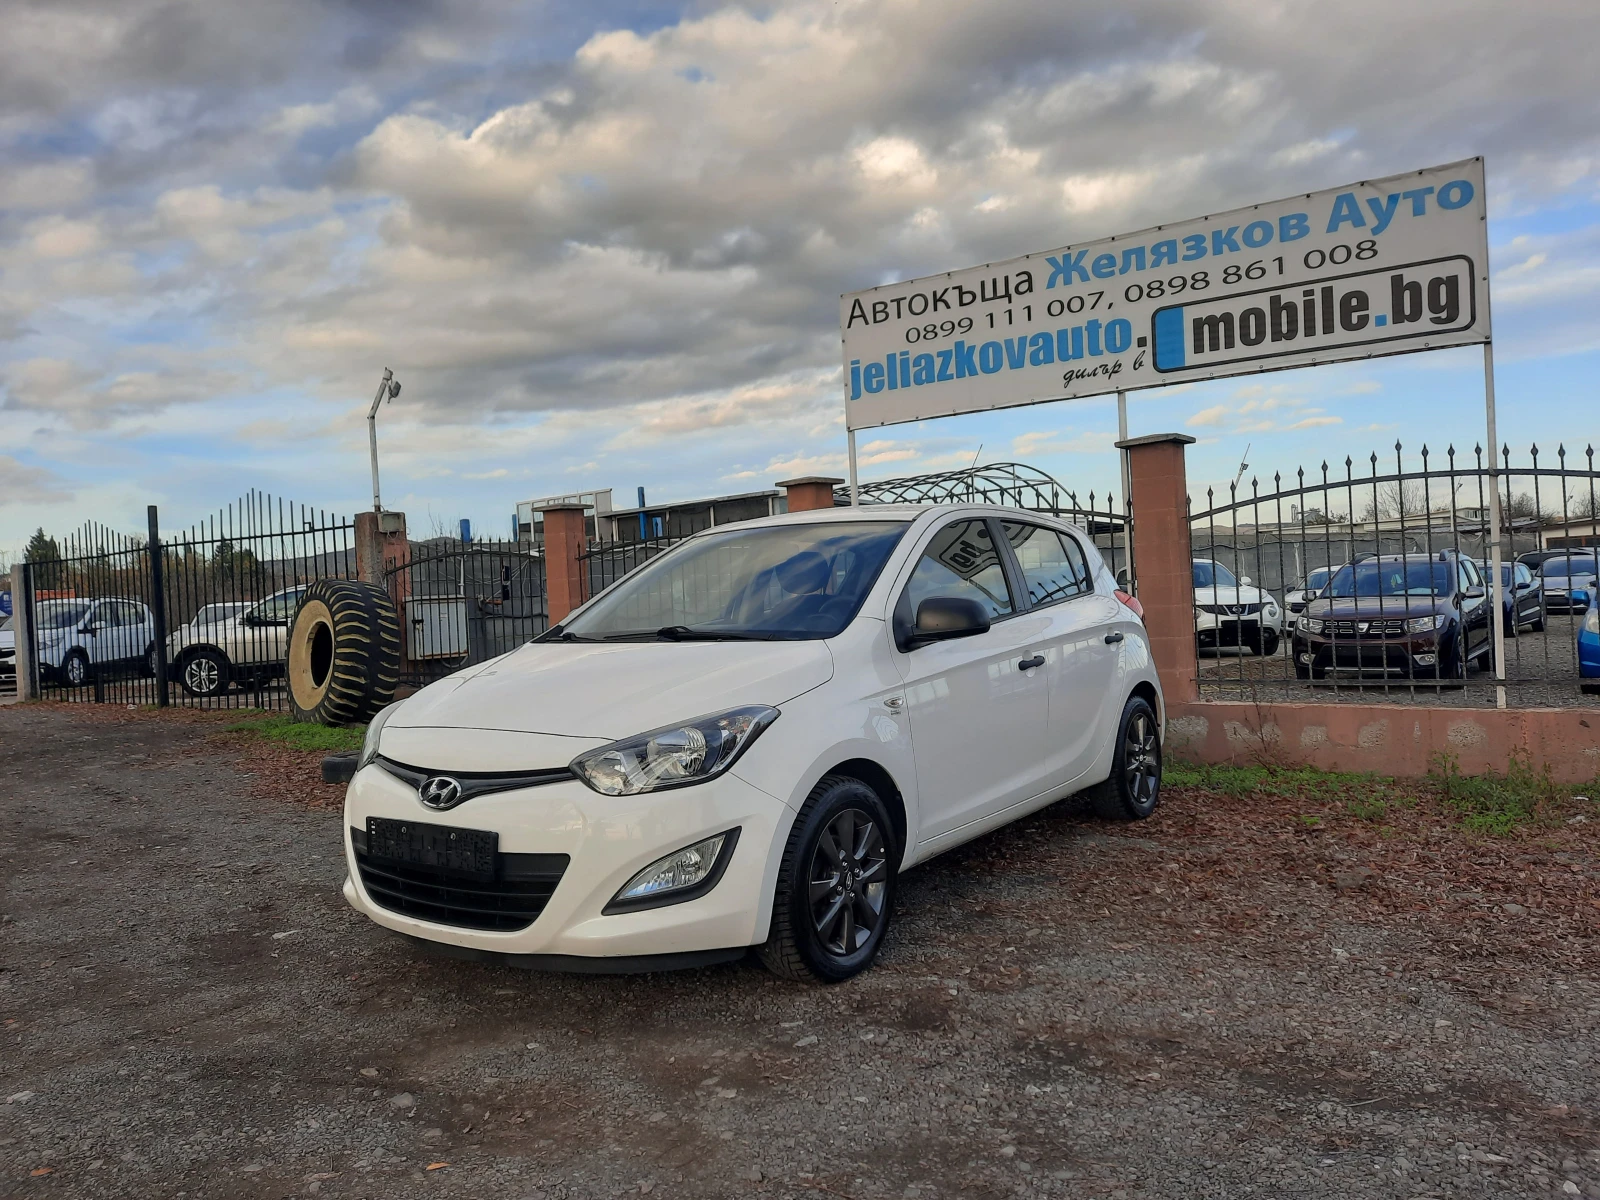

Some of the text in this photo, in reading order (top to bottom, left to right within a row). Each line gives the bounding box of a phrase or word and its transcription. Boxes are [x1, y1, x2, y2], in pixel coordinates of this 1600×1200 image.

[847, 179, 1475, 329] Автокъща Желязков Ауто
[905, 239, 1379, 344] 0899 111 007, 0898 861 008
[1192, 273, 1460, 355] mobile.bg
[1063, 359, 1123, 389] дилър
